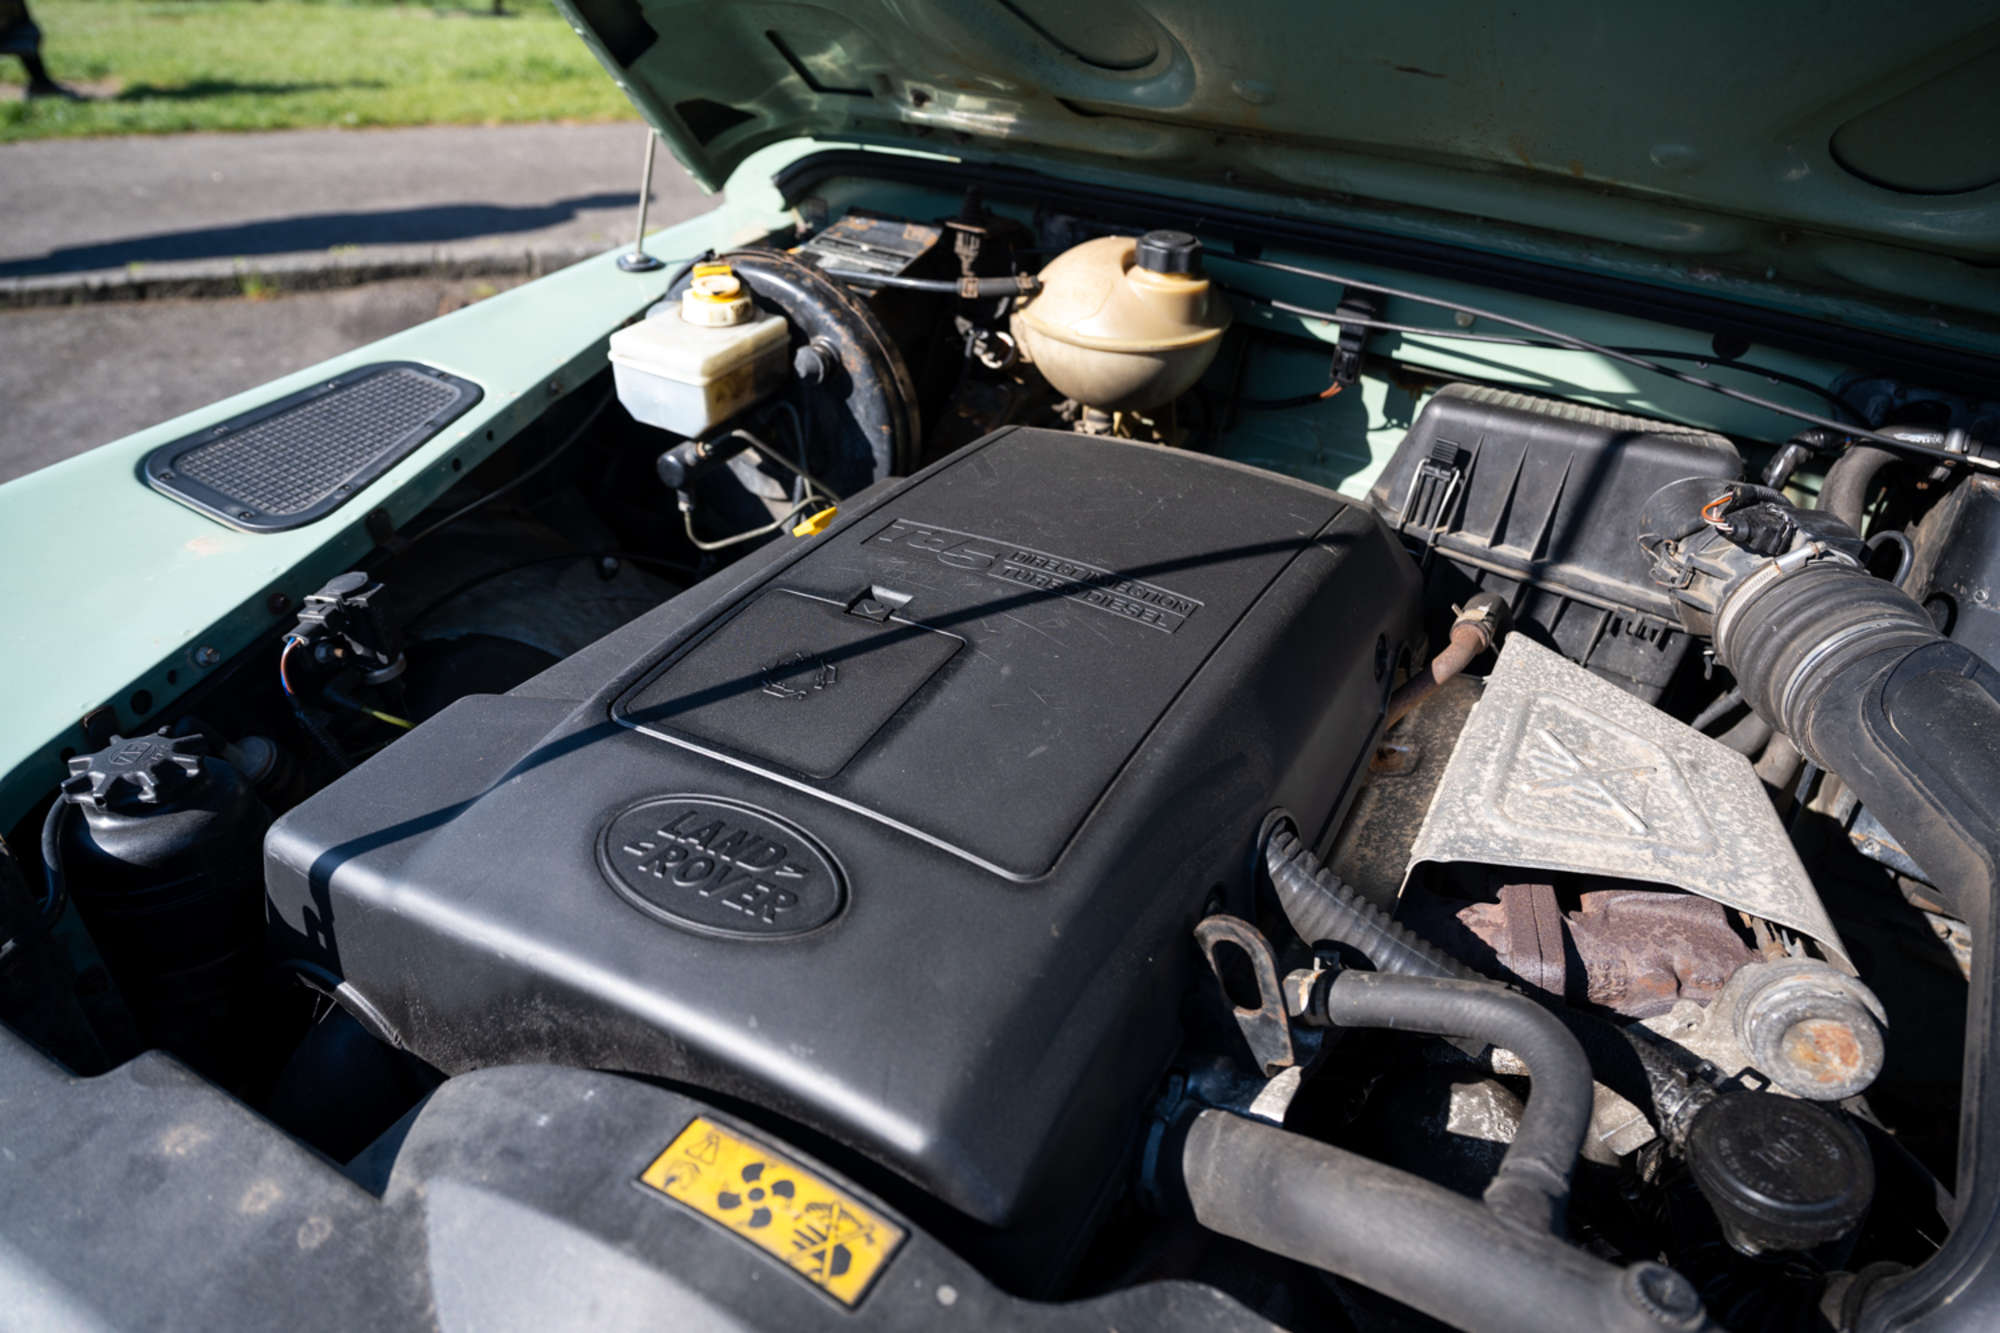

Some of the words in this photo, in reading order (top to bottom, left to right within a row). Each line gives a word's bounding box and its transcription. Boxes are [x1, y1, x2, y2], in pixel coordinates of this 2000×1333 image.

[1009, 551, 1086, 577] DIRECT
[1082, 569, 1193, 612] INECTION
[1083, 590, 1168, 627] DIESEL
[656, 810, 788, 872] LAND
[636, 845, 800, 924] ROVER
